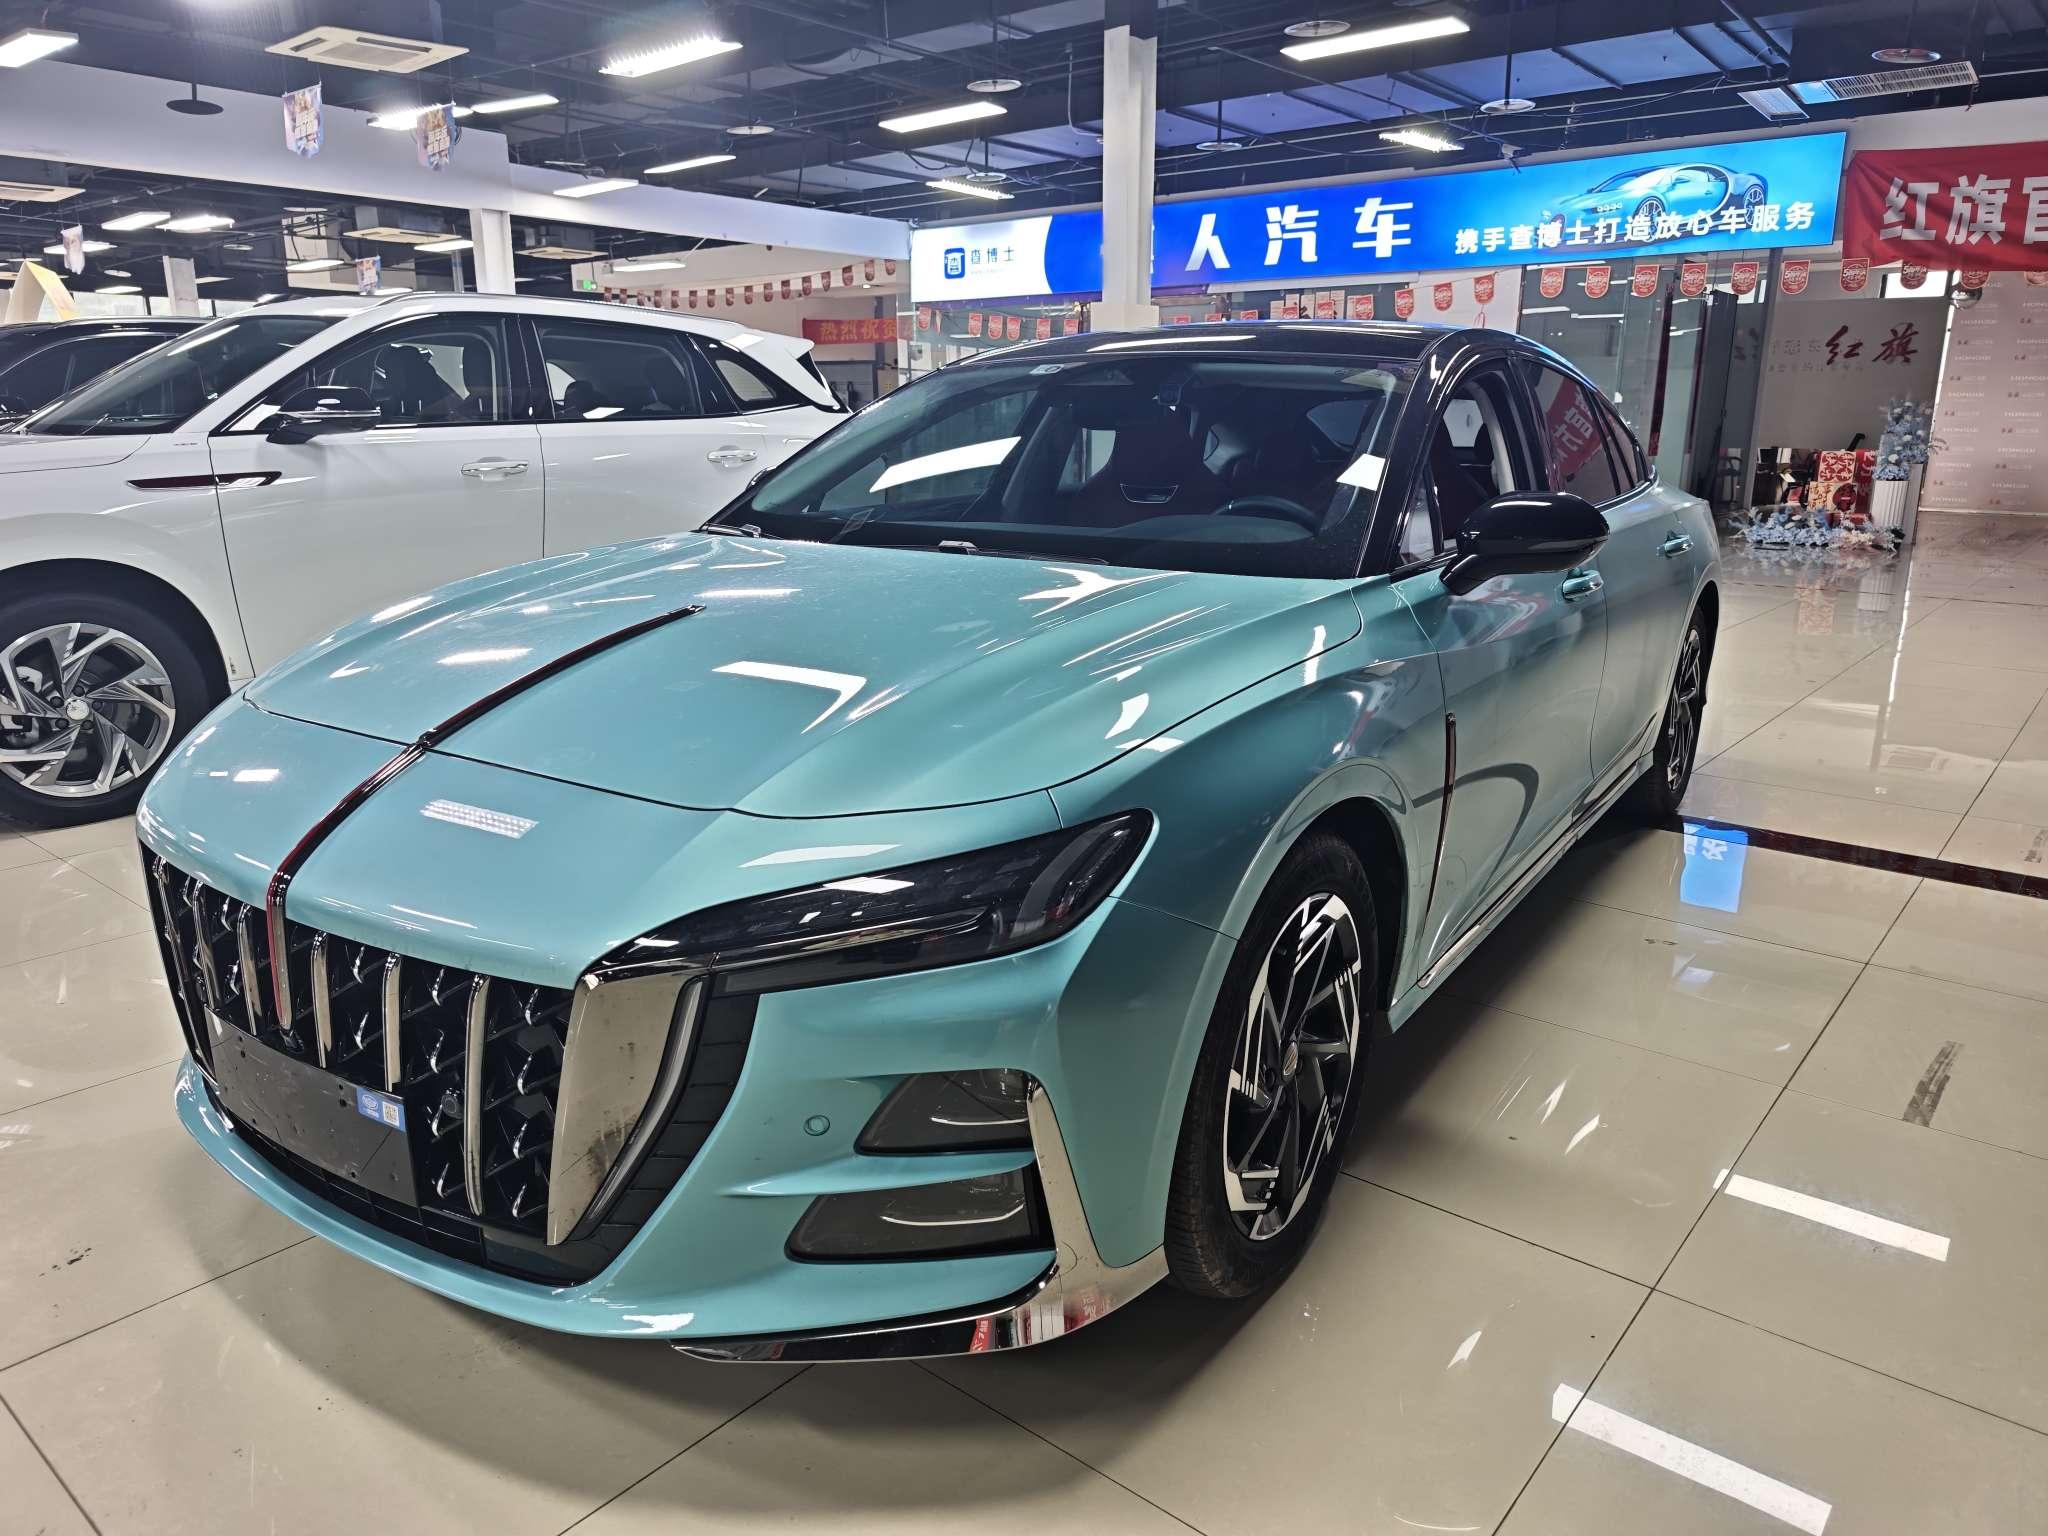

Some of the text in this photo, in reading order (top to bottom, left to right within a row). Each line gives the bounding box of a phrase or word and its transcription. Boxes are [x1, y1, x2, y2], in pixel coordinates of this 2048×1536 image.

[1150, 197, 1414, 273] 人汽车
[1455, 202, 1815, 254] 携手查博士打造放心车服务
[1825, 322, 1919, 366] 红旗
